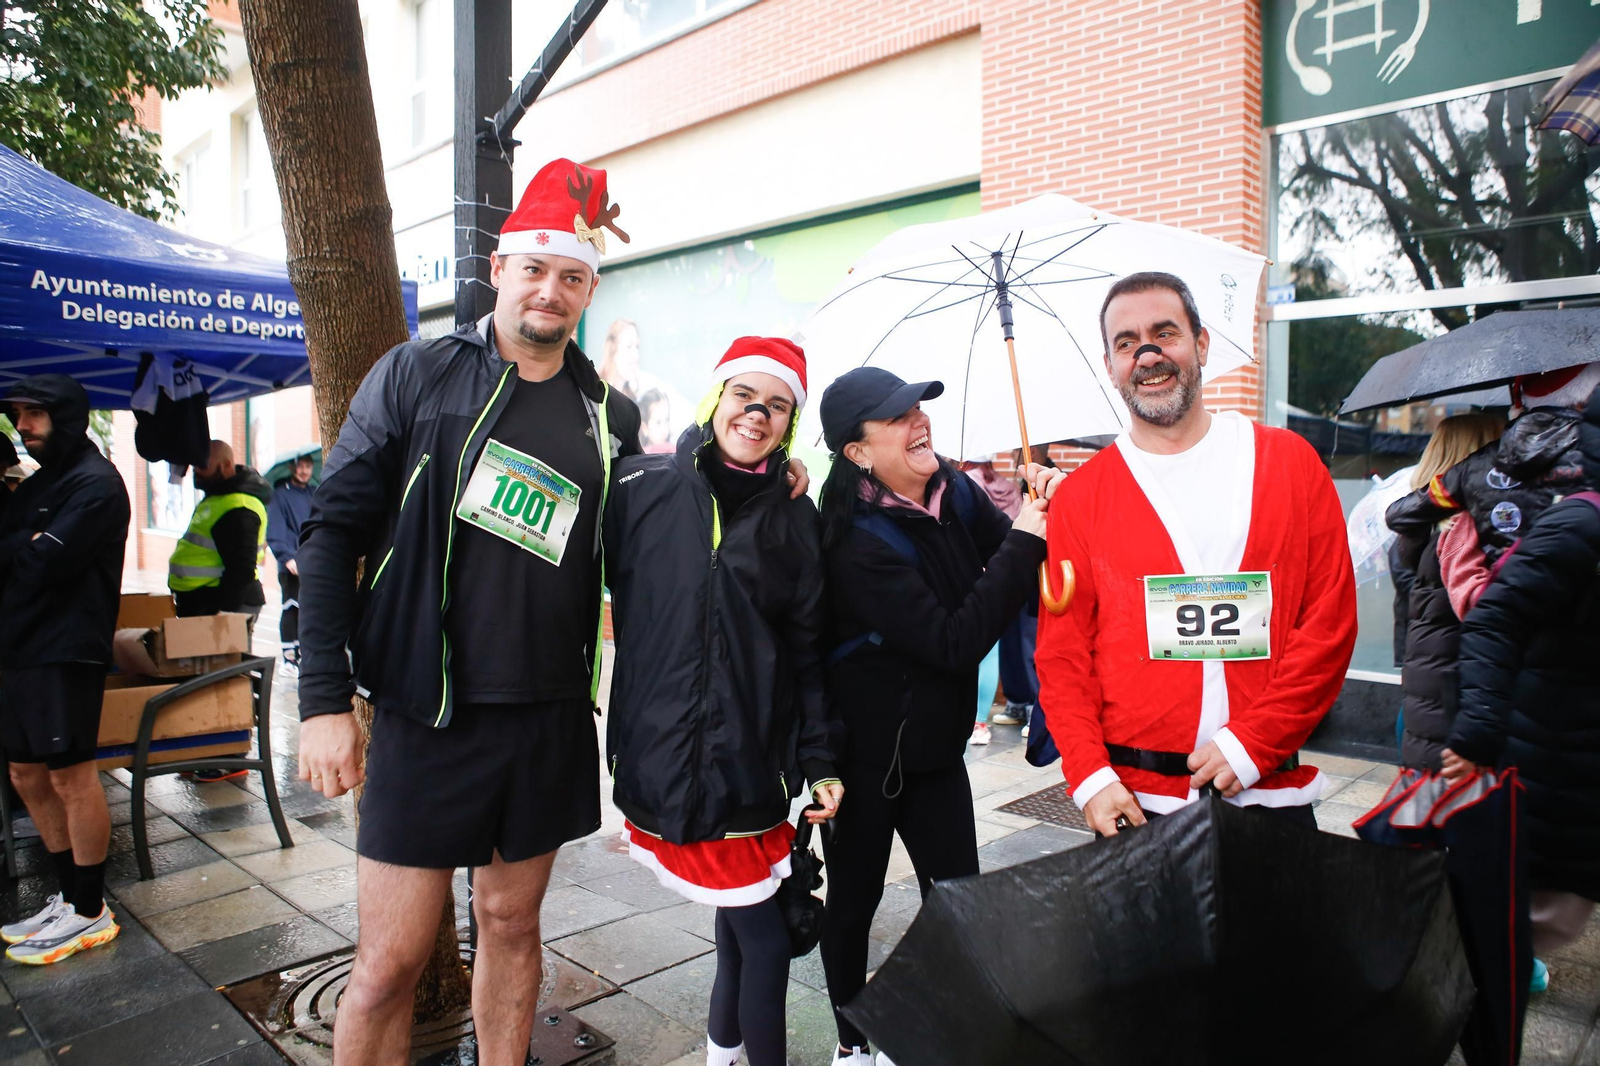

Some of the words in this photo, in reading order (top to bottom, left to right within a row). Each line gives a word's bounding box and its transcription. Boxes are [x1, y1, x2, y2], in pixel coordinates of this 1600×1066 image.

[30, 269, 212, 308] Ayuntamiento
[217, 289, 246, 310] de
[251, 292, 302, 319] Alge
[62, 300, 195, 331] Delegación
[200, 312, 227, 334] de
[231, 315, 305, 340] Deport
[503, 457, 541, 482] CARRERA
[618, 469, 645, 485] TRIBORD
[480, 505, 498, 518] CAMINO
[515, 522, 527, 531] JUAN
[489, 474, 558, 535] 1001
[1168, 583, 1209, 597] CARRERA
[1210, 581, 1248, 595] NAVIDAD
[1176, 603, 1241, 637] 92
